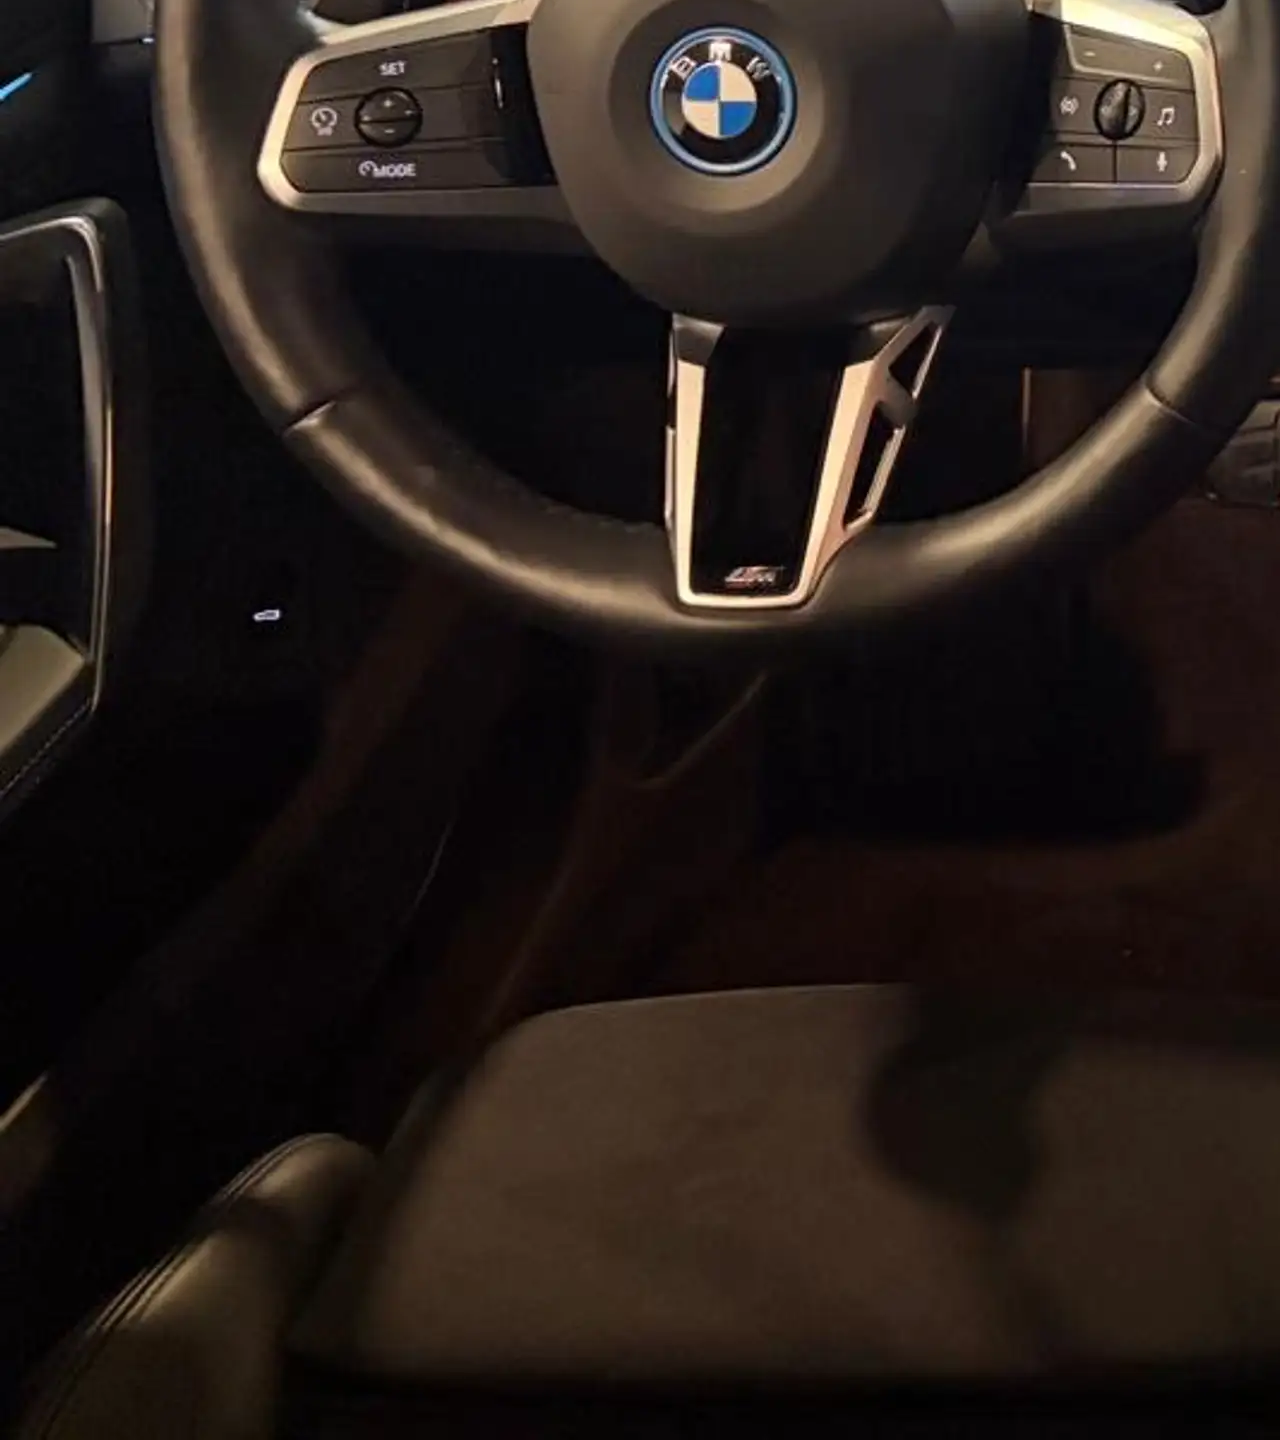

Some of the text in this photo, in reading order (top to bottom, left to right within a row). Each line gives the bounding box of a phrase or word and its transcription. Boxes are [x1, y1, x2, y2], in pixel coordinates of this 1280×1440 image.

[379, 62, 406, 76] SET
[670, 42, 772, 81] BMW
[373, 163, 416, 178] MODE
